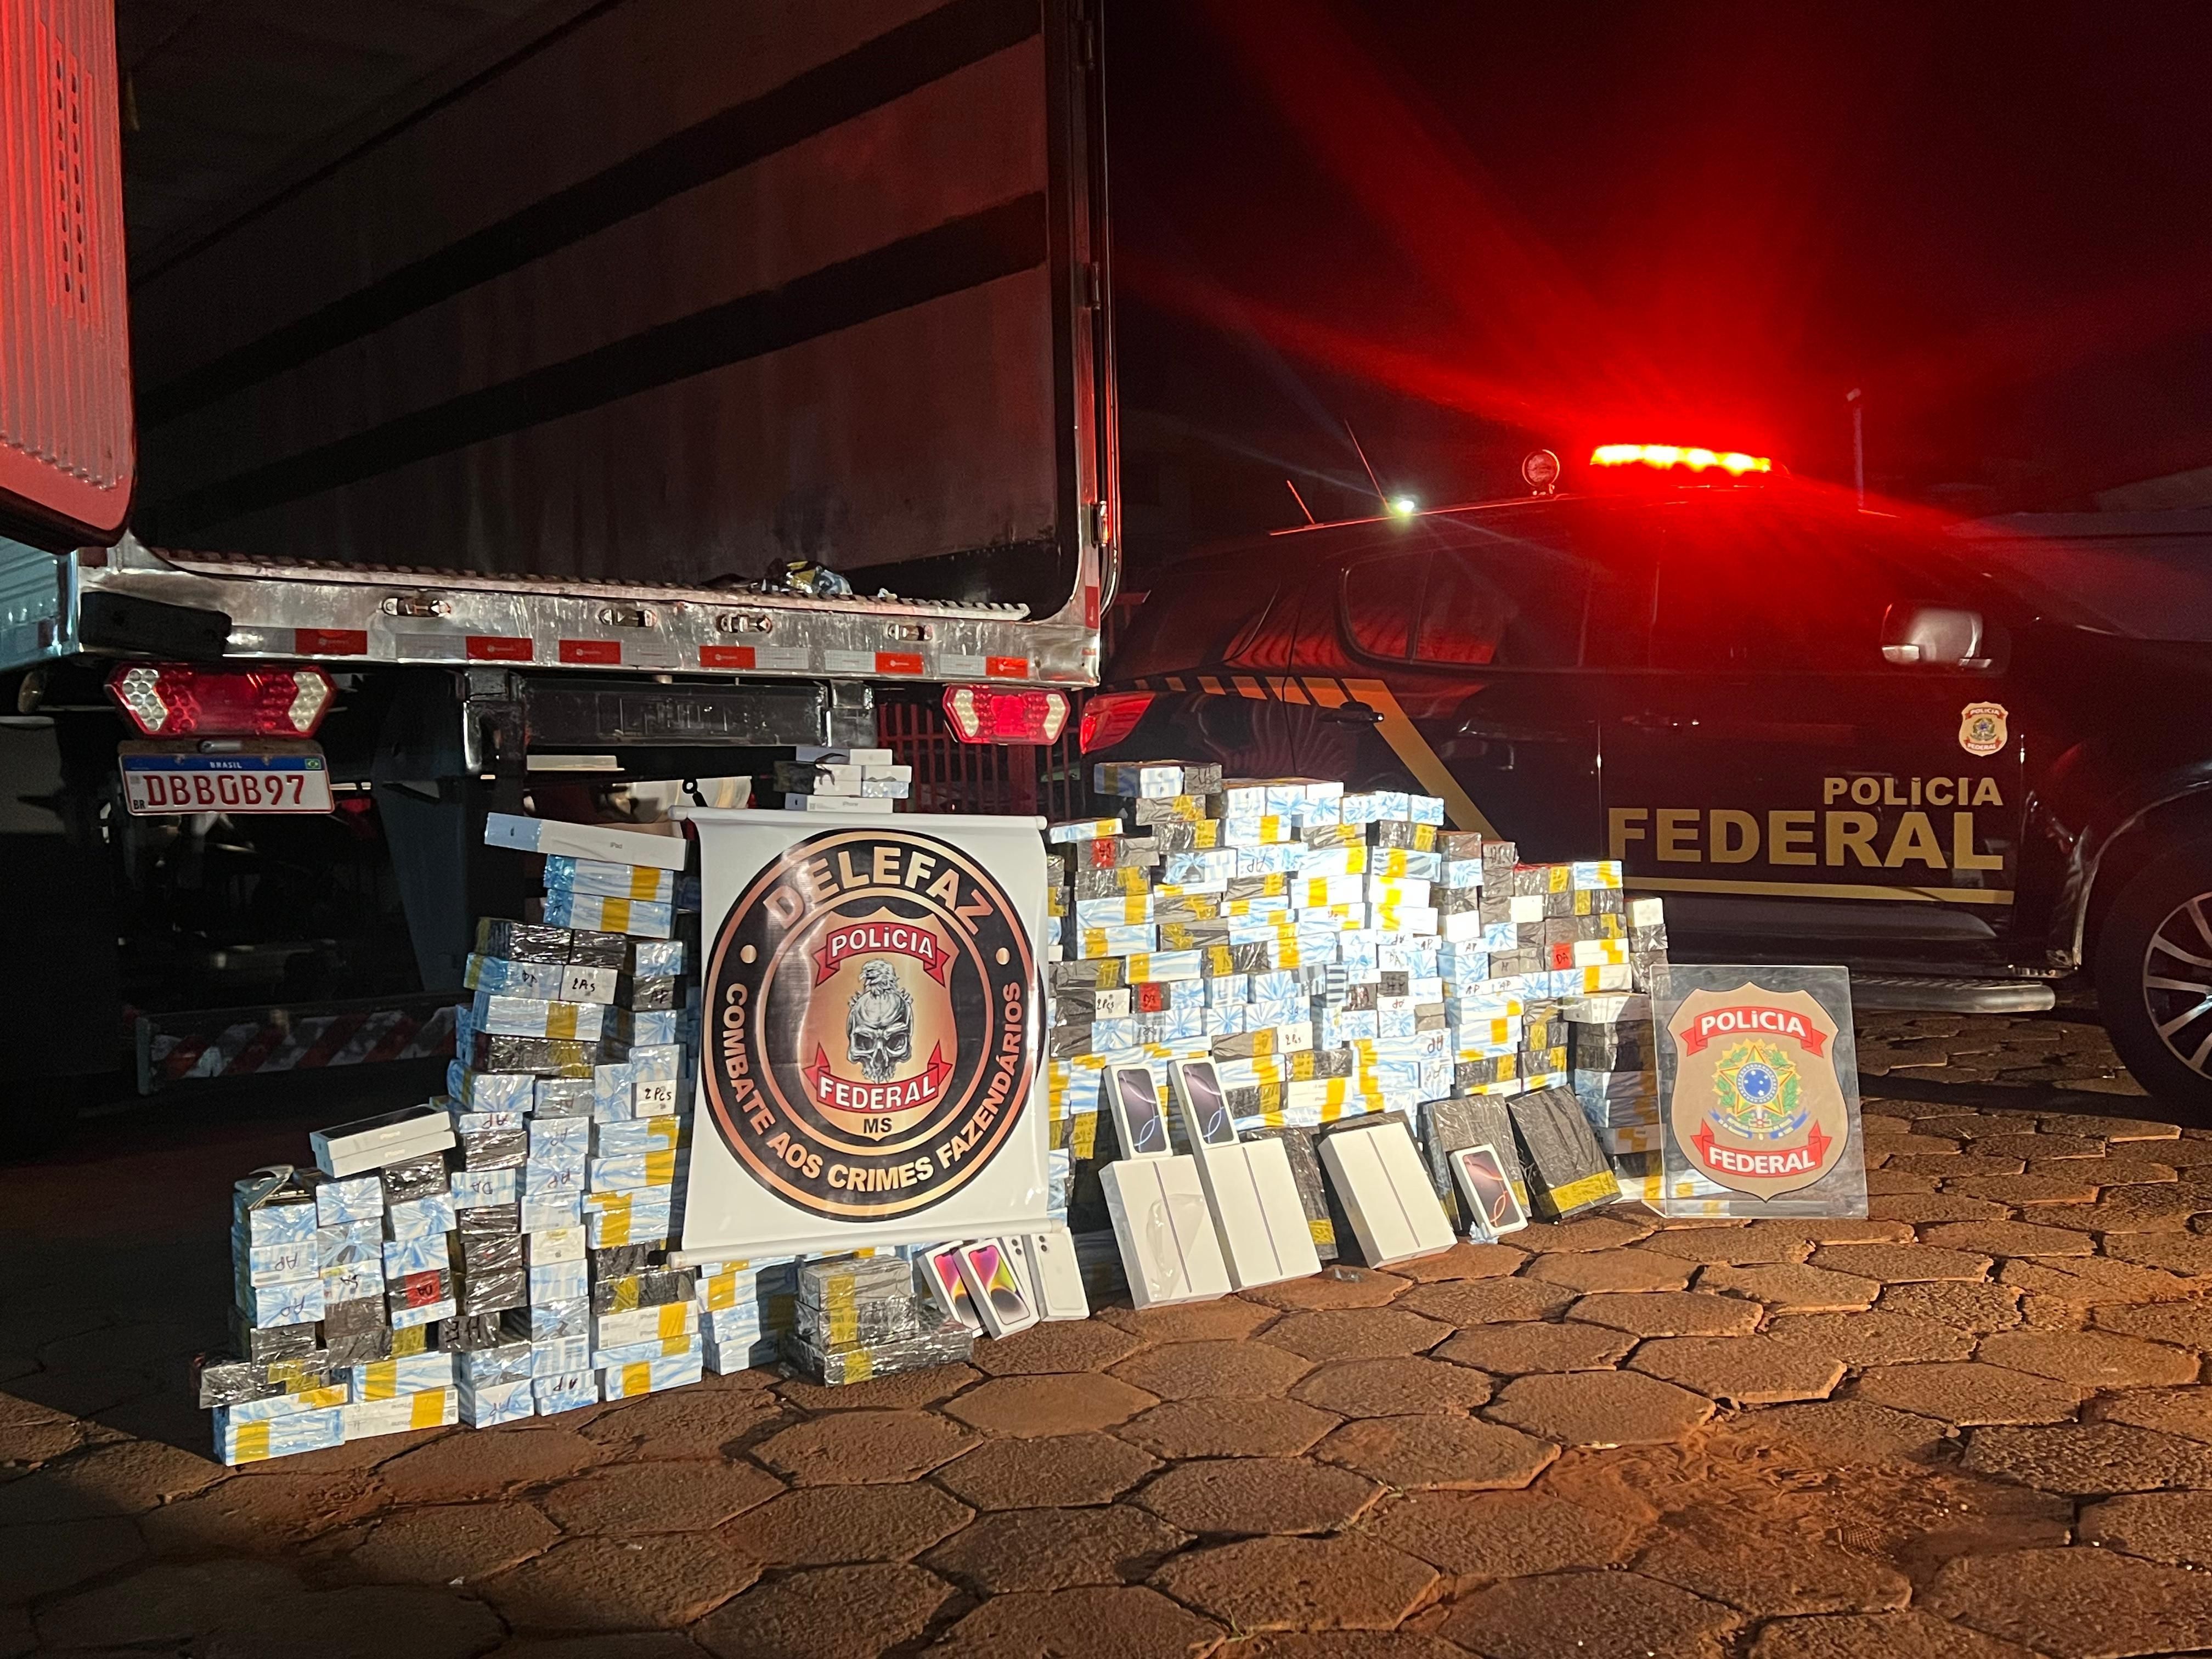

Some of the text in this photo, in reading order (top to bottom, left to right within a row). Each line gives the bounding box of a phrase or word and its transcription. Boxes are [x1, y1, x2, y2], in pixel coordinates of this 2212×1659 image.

[133, 799, 146, 810] BR
[1608, 807, 2004, 871] FEDERAL
[763, 846, 994, 935] DELEFAZ
[1427, 1035, 1444, 1053] AP
[645, 1088, 651, 1100] 2
[723, 982, 1021, 1192] COMBATE AOS CRIMES FAZENDÁRIOS
[817, 1073, 938, 1110] FEDERAL
[482, 1114, 509, 1129] AP
[863, 1117, 892, 1135] MS
[1708, 1146, 1816, 1175] FEDERAL
[274, 1252, 297, 1271] AP
[553, 1376, 578, 1392] AP
